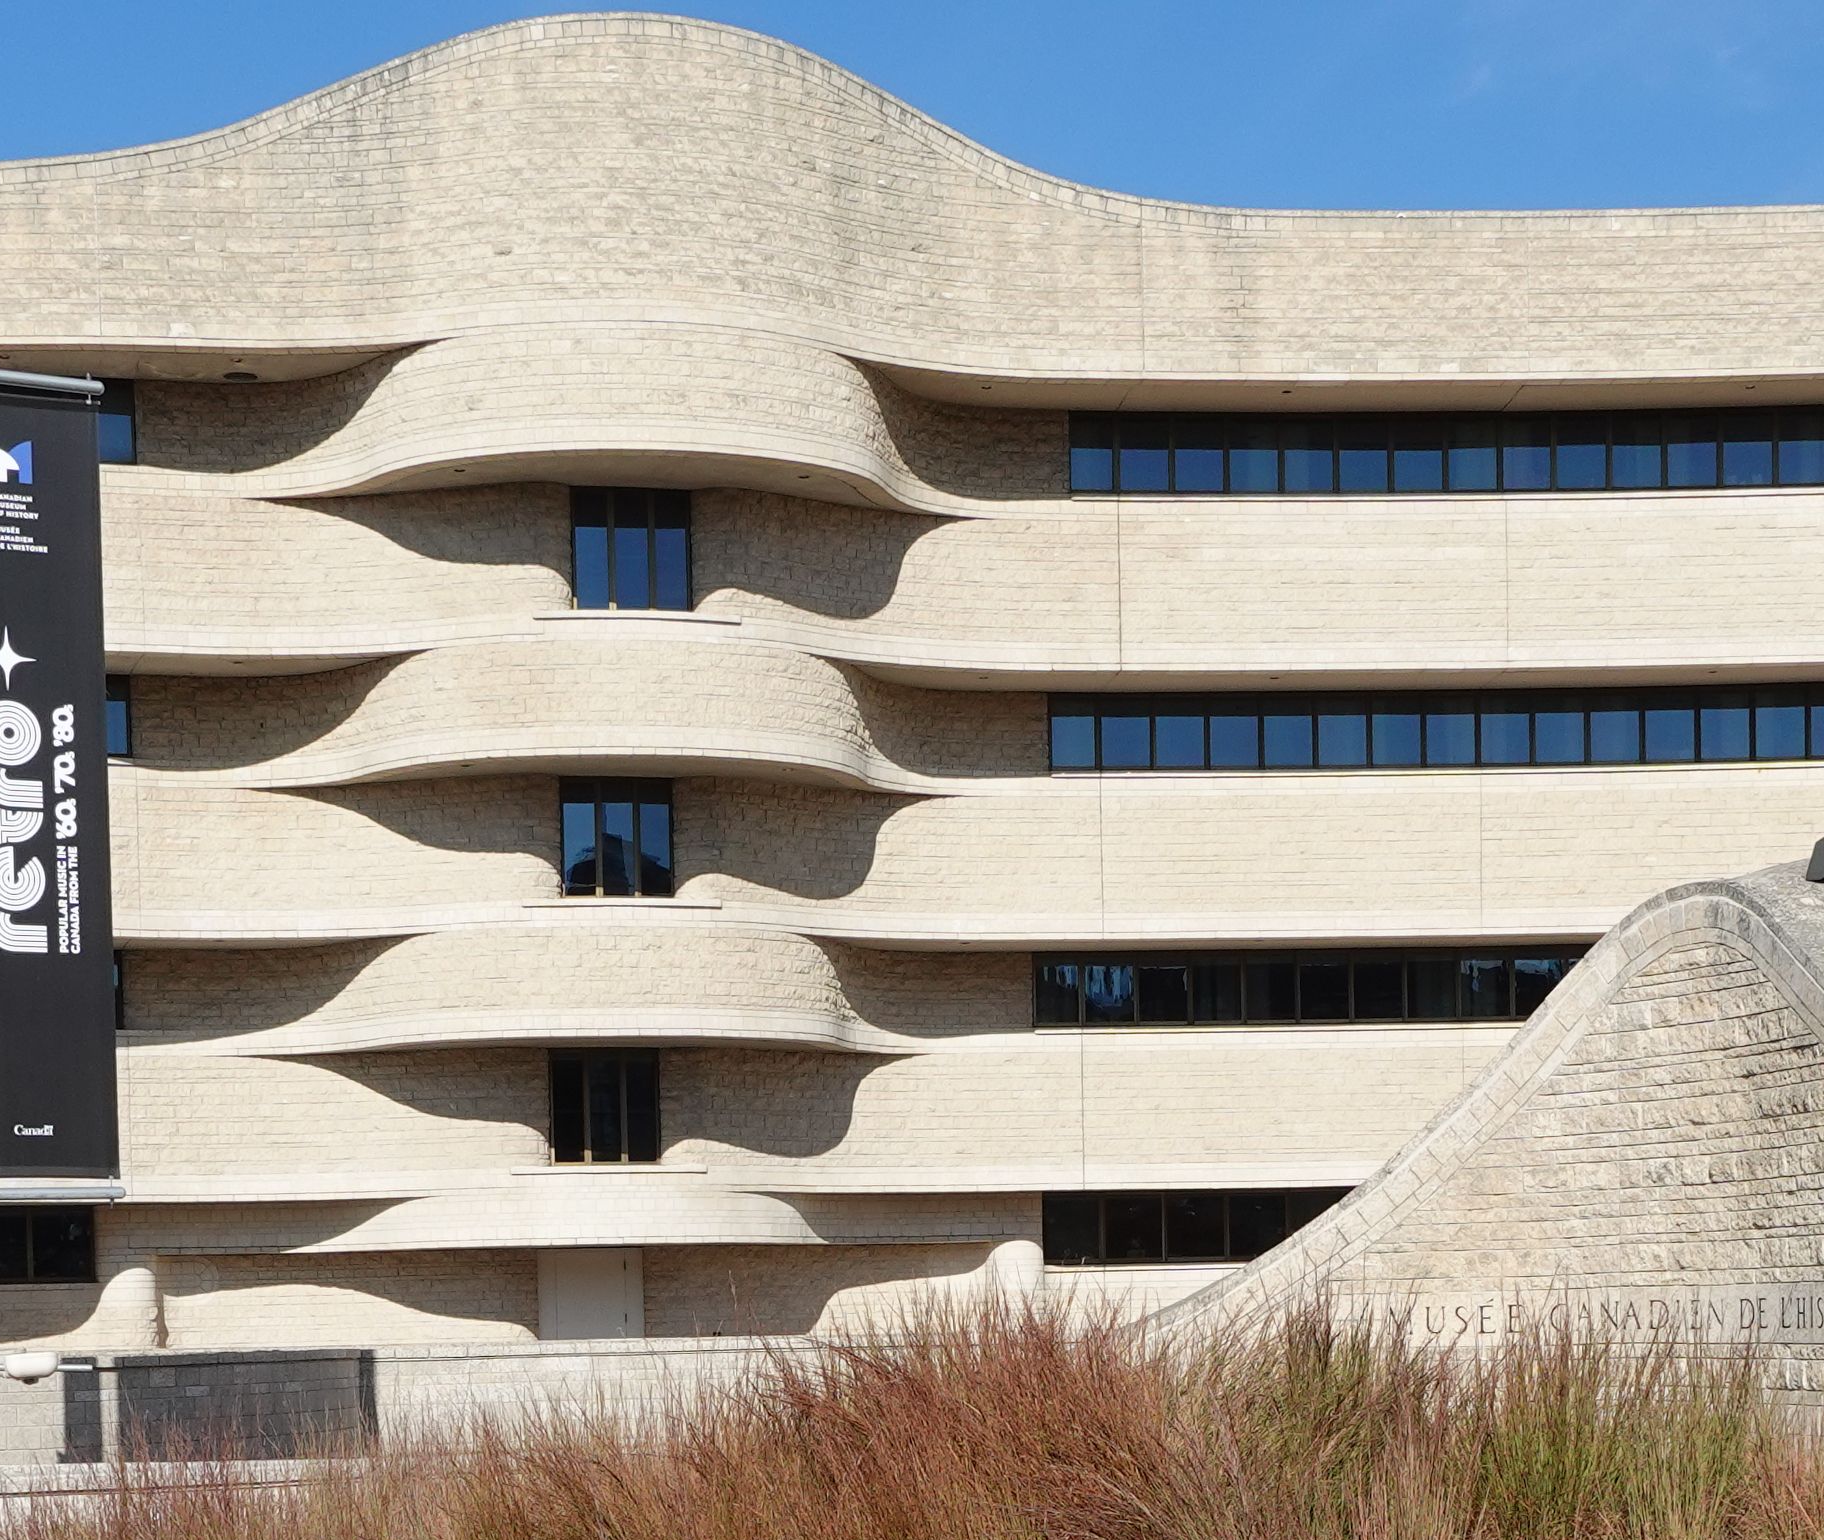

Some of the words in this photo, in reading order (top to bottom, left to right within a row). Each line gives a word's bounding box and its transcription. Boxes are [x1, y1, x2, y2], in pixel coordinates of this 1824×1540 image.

[56, 845, 66, 859] IN
[67, 846, 78, 869] THE
[57, 860, 67, 897] MUSIC
[68, 871, 79, 904] FROM
[58, 899, 69, 953] POPULAR
[69, 905, 80, 954] CANADA
[13, 1124, 54, 1136] Canada
[1388, 1298, 1524, 1336] MUSÉE
[1740, 1297, 1768, 1330] DE
